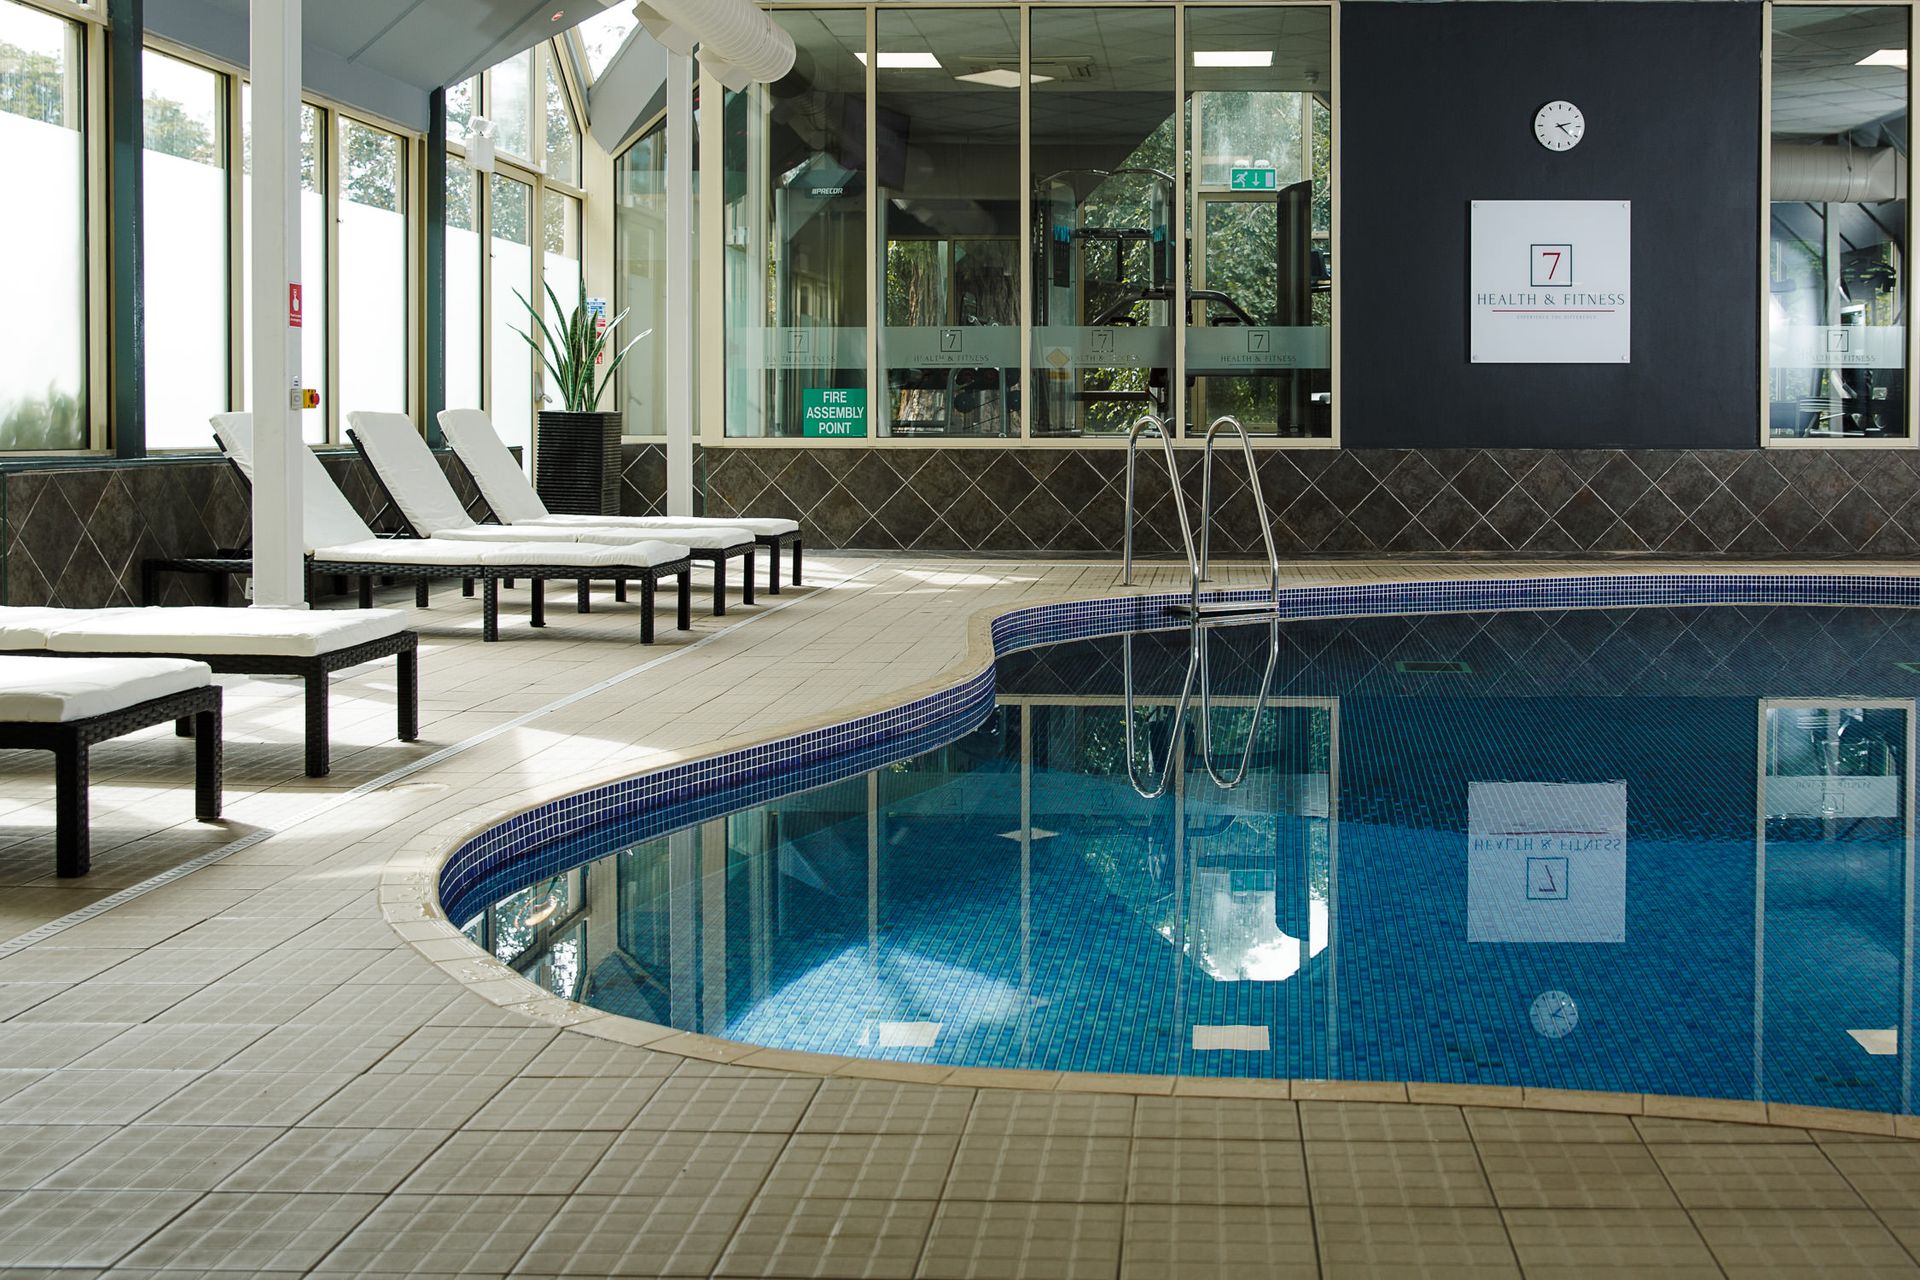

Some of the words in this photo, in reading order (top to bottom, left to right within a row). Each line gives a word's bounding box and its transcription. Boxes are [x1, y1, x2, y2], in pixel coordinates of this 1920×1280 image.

[1542, 252, 1561, 280] 7
[1477, 293, 1537, 305] HEALTH
[1544, 293, 1555, 305] &
[1564, 293, 1625, 305] FITNESS
[946, 333, 957, 349] 7
[1098, 333, 1108, 349] 7
[1253, 334, 1264, 350] 7
[1833, 333, 1843, 349] 7
[823, 391, 847, 403] FIRE
[806, 406, 864, 419] ASSEMBLY
[818, 422, 852, 434] POINT
